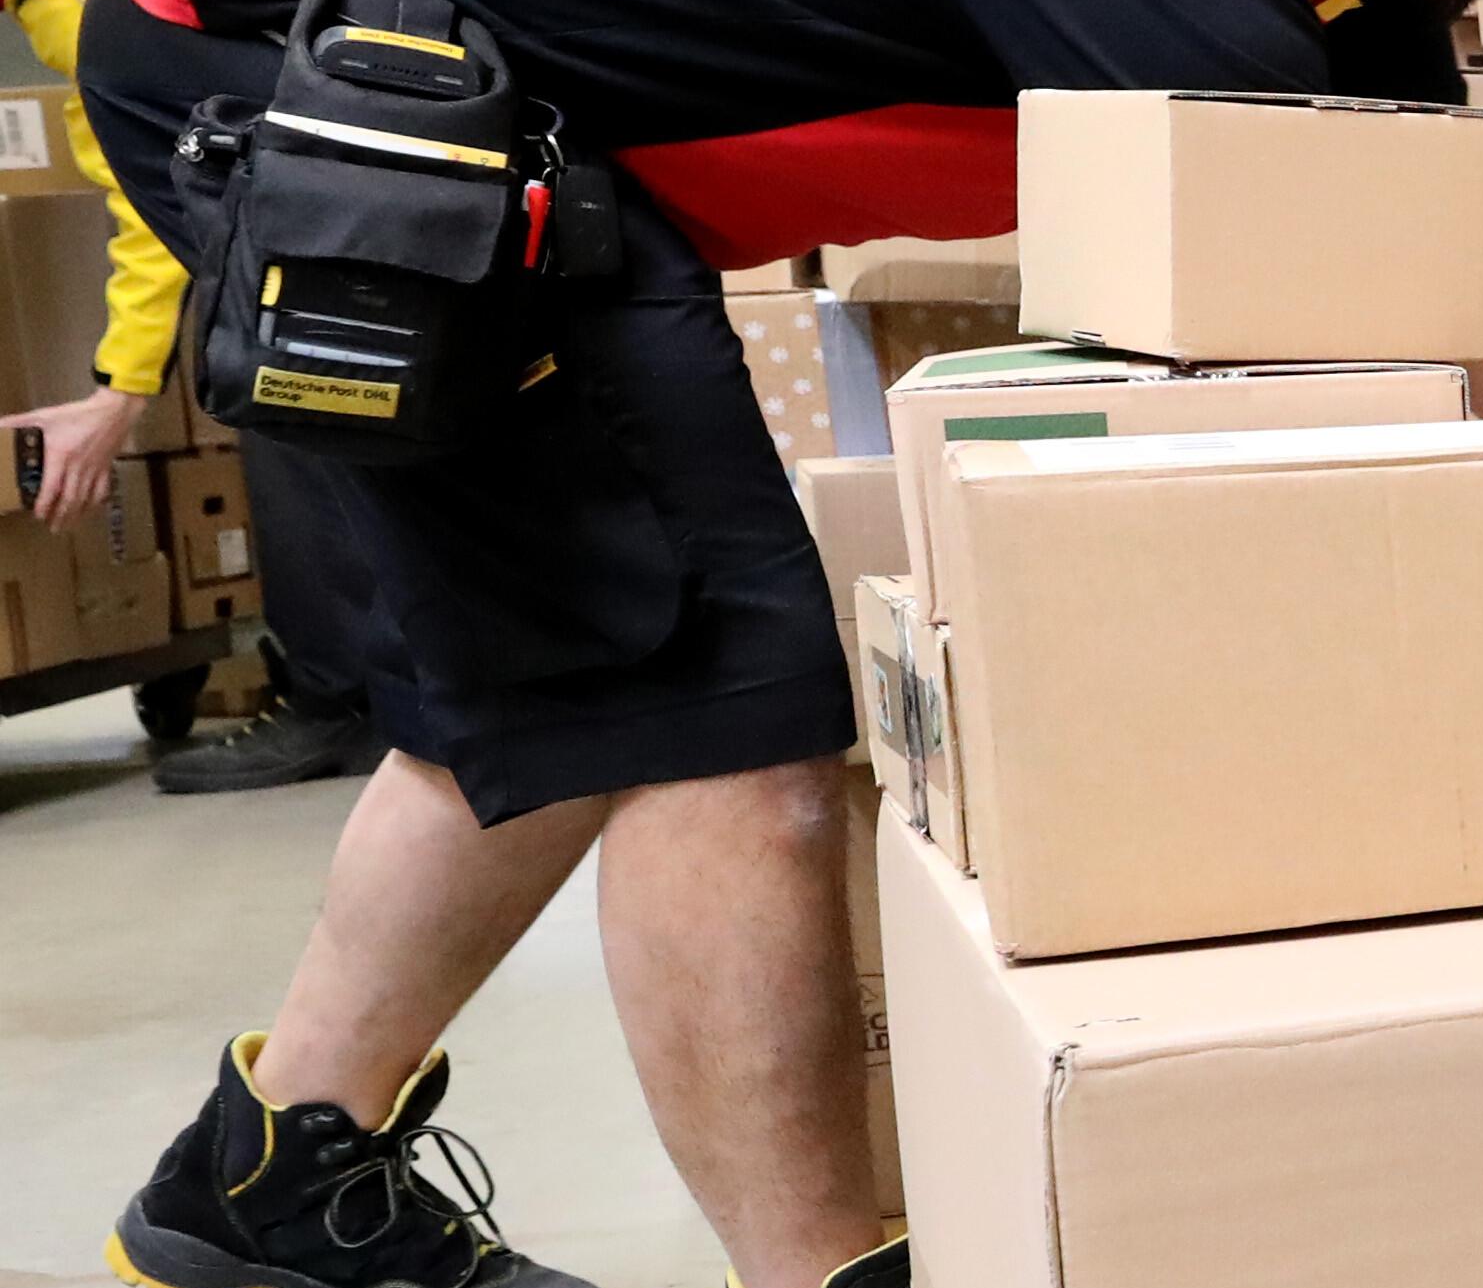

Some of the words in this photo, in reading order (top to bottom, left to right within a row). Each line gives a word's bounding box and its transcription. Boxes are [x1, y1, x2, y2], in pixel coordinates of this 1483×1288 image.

[259, 387, 303, 402] Group
[260, 374, 326, 396] Deutsche
[328, 384, 358, 398] Post
[363, 389, 391, 402] DHL
